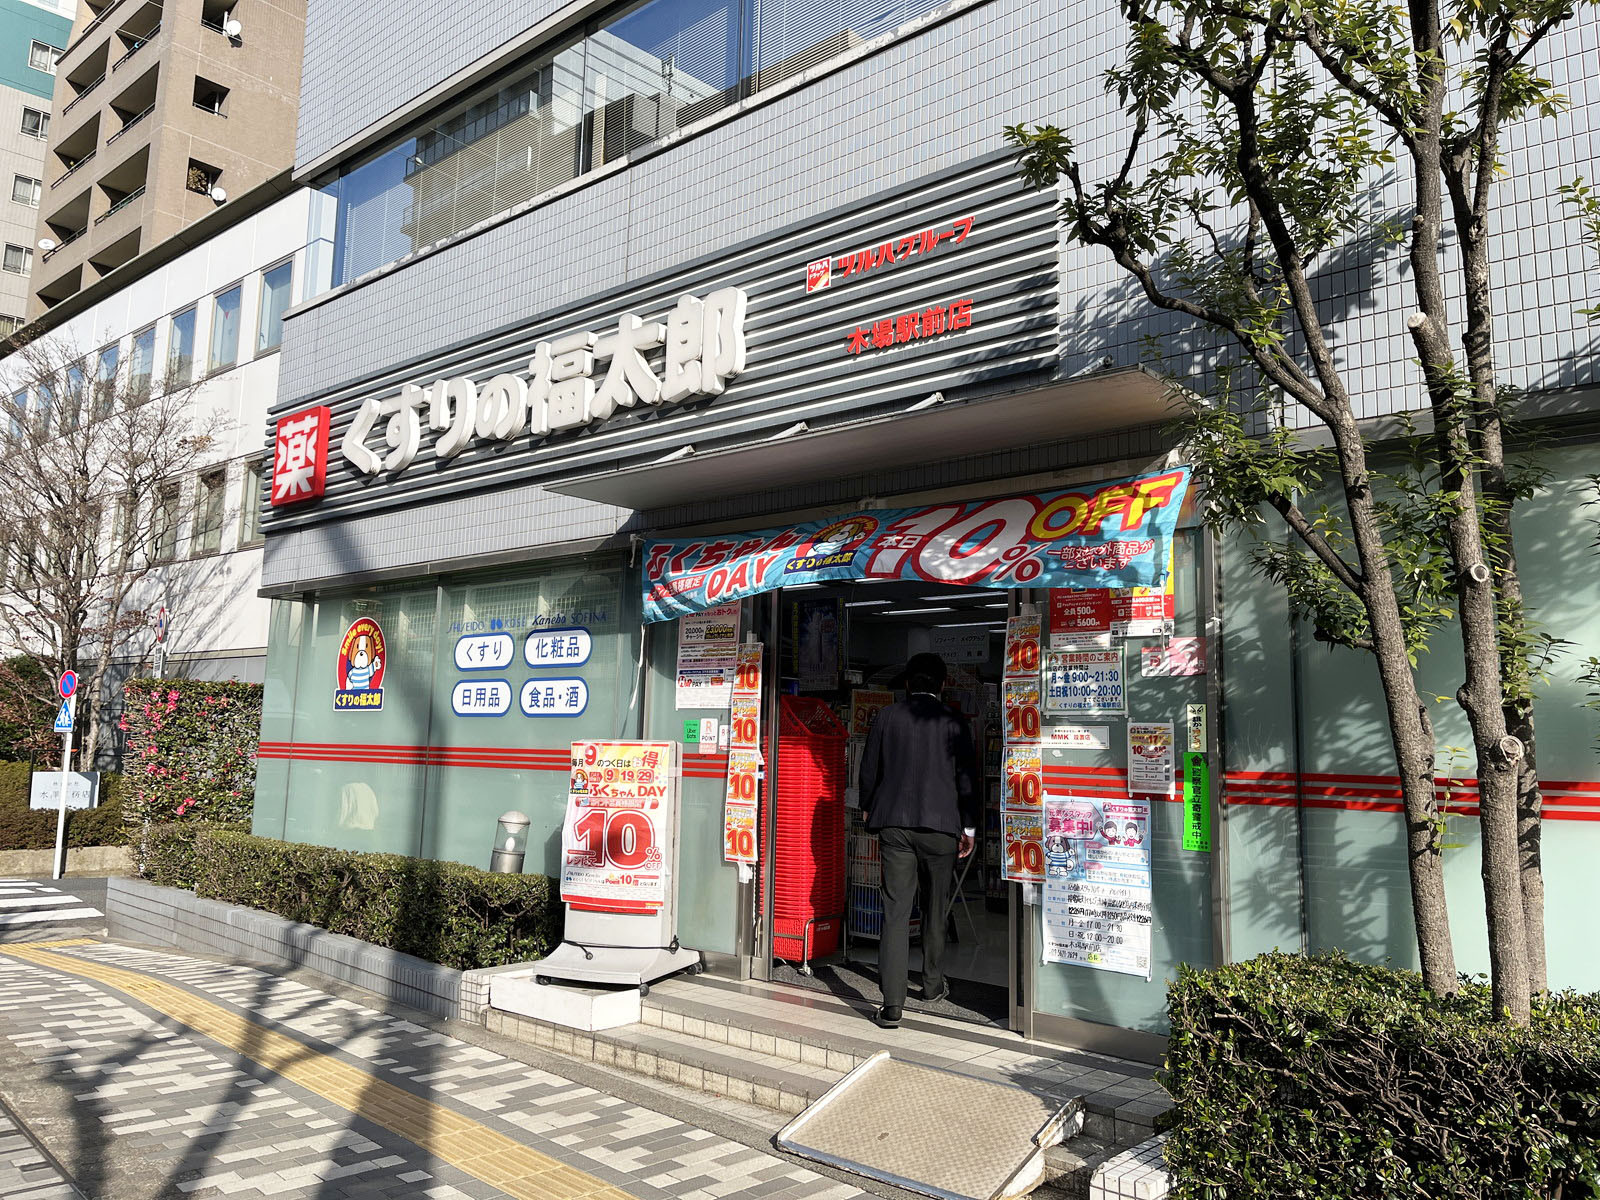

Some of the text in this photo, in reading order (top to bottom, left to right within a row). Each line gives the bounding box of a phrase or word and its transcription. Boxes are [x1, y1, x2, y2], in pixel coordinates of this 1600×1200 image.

[838, 216, 975, 278] ツルハグループ
[847, 299, 973, 354] 木場駅前店
[341, 286, 748, 476] くすりの福太郎
[276, 414, 319, 499] 薬
[1026, 473, 1182, 539] OFF
[645, 527, 806, 581] ふくちゃん
[879, 534, 922, 550] 本日
[786, 552, 854, 571] くすりの福太郎
[704, 554, 780, 604] DAY
[447, 621, 486, 634] SHISEIDO
[532, 614, 568, 627] Kanebo
[570, 611, 609, 625] SOFINA
[466, 641, 503, 662] くすり
[535, 636, 580, 659] 化粧品
[1006, 638, 1040, 671] 10
[1061, 653, 1119, 664] 営業時間のご案内
[736, 663, 761, 690] 10
[335, 693, 381, 706] くすりの福太郎
[461, 687, 501, 708] 日用品
[528, 686, 580, 708] 食品・酒
[732, 717, 758, 743] 10
[1006, 704, 1040, 738] 10
[621, 771, 635, 781] 19
[638, 771, 652, 782] 29
[729, 773, 757, 800] 10
[1007, 771, 1041, 806] 10
[590, 784, 636, 798] ふくちゃん
[638, 785, 667, 797] DAY
[1191, 767, 1202, 840] 警察官立寄警戒中
[1048, 817, 1094, 836] 募集中!
[1049, 808, 1092, 819] 元気なスタッフ
[726, 829, 754, 857] 10
[1006, 839, 1045, 875] 10
